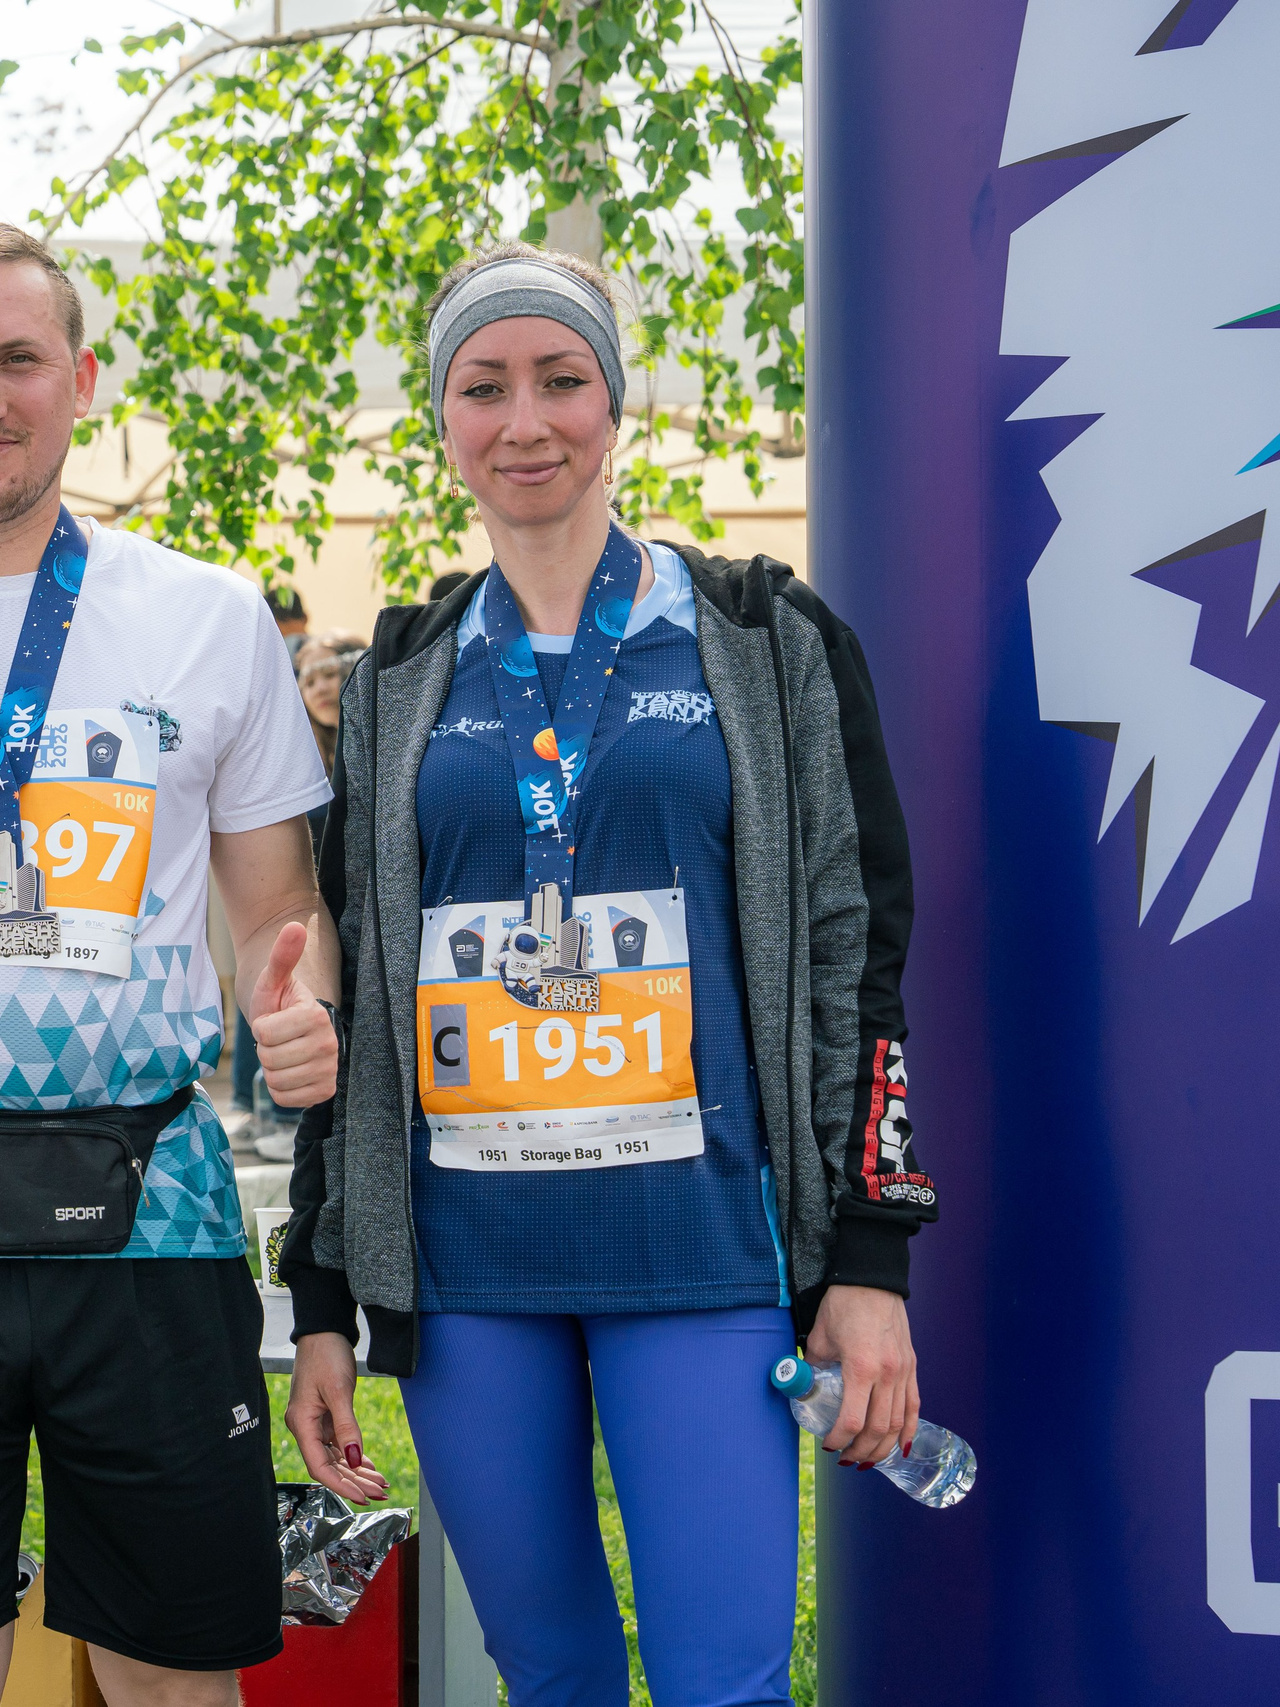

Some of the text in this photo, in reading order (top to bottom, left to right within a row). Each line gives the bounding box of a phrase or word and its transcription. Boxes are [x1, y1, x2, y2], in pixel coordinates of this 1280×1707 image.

[5, 703, 37, 753] 10K
[53, 723, 68, 768] 2026
[112, 792, 149, 813] 10K
[529, 780, 559, 831] 10K
[0, 925, 53, 940] TASH
[65, 947, 99, 960] 1897
[539, 981, 591, 996] TASH
[644, 976, 683, 996] 10K
[538, 992, 591, 1008] KENT
[433, 1026, 461, 1068] C
[489, 1011, 663, 1082] 1951
[867, 1109, 882, 1144] ELITE
[478, 1140, 649, 1164] 1951 Storage Bag 1951
[55, 1206, 106, 1221] SPORT
